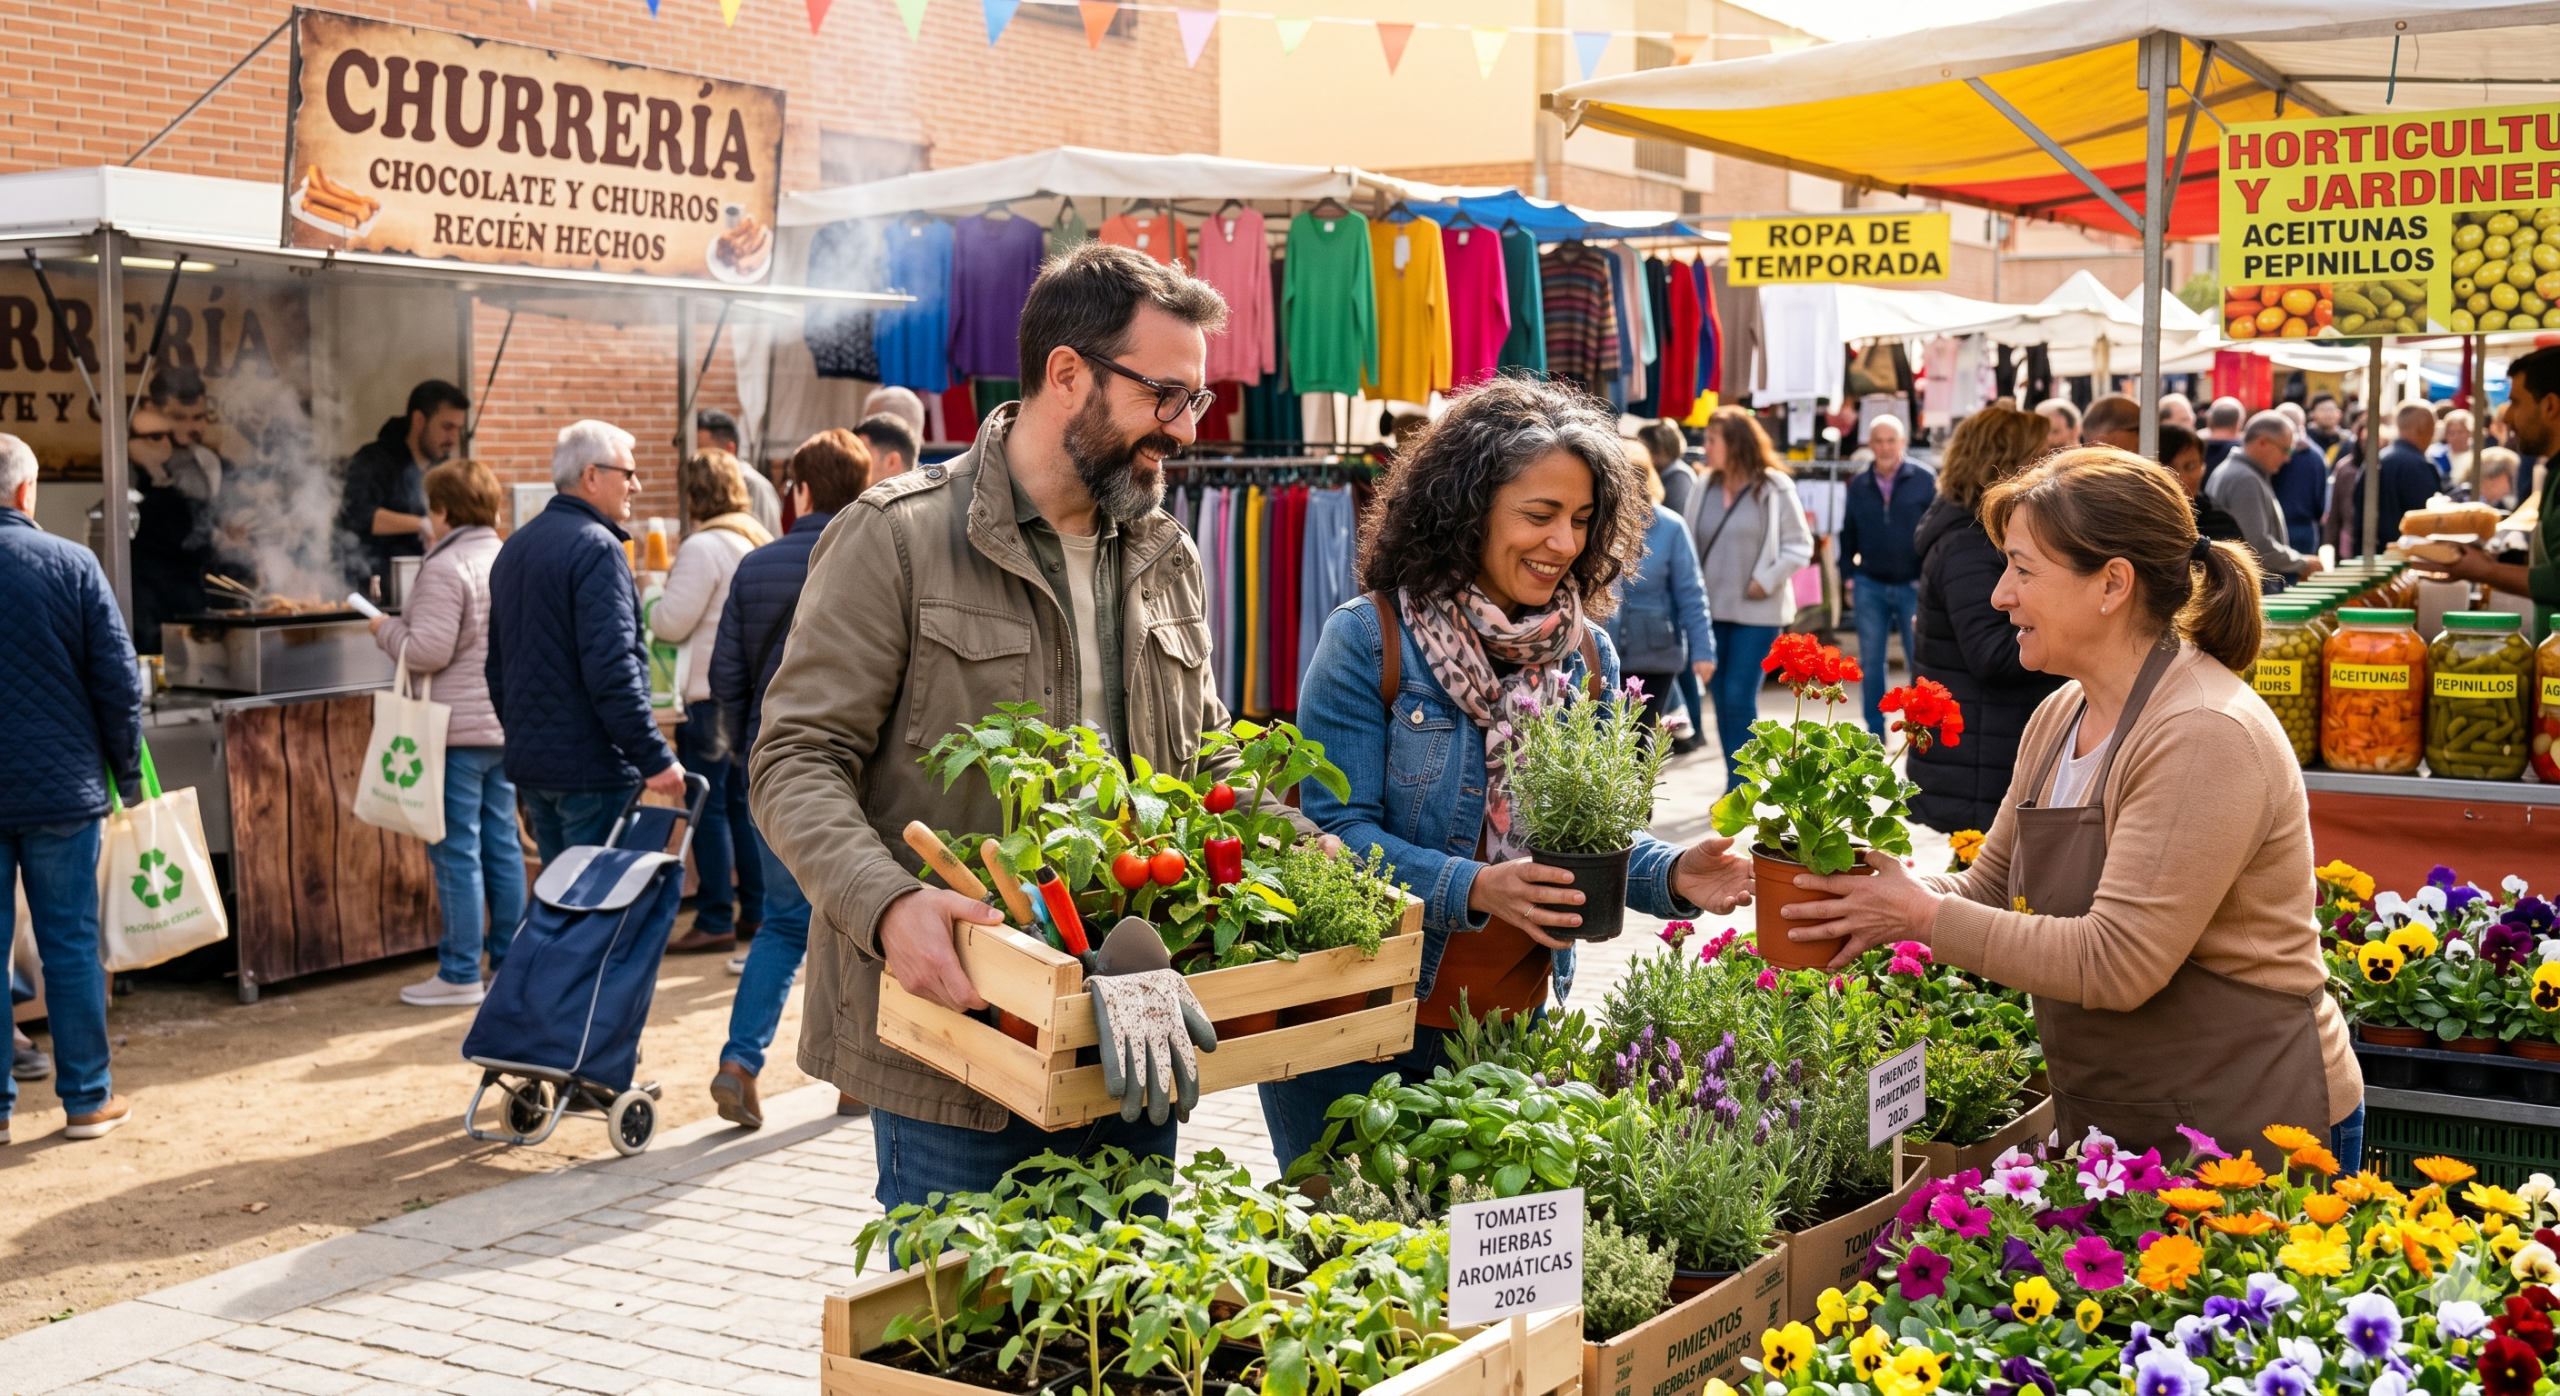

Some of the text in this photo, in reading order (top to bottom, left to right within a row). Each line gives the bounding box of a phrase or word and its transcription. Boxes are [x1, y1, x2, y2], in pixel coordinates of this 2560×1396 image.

[326, 49, 756, 182] CHURRERÍA
[2228, 112, 2560, 170] HORTICULTU
[369, 157, 720, 224] CHOCOLATE Y CHURROS
[2234, 160, 2560, 214] Y JARDINER
[433, 212, 666, 262] RECIÉN HECHOS
[1768, 221, 1910, 248] ROPA DE
[2242, 215, 2428, 248] ACEITUNAS
[1735, 252, 1942, 279] TEMPORADA
[2244, 247, 2434, 279] PEPINILLOS
[2332, 669, 2407, 683] ACEITUNAS
[2436, 678, 2514, 692] PEPINILLOS
[1475, 1201, 1557, 1230] TOMATES
[1479, 1229, 1552, 1257] HIERBAS
[1457, 1251, 1573, 1288] AROMÁTICAS
[1494, 1285, 1536, 1309] 2026
[1666, 1306, 1743, 1369] PIMIENTOS
[1652, 1364, 1696, 1396] HIERBAS
